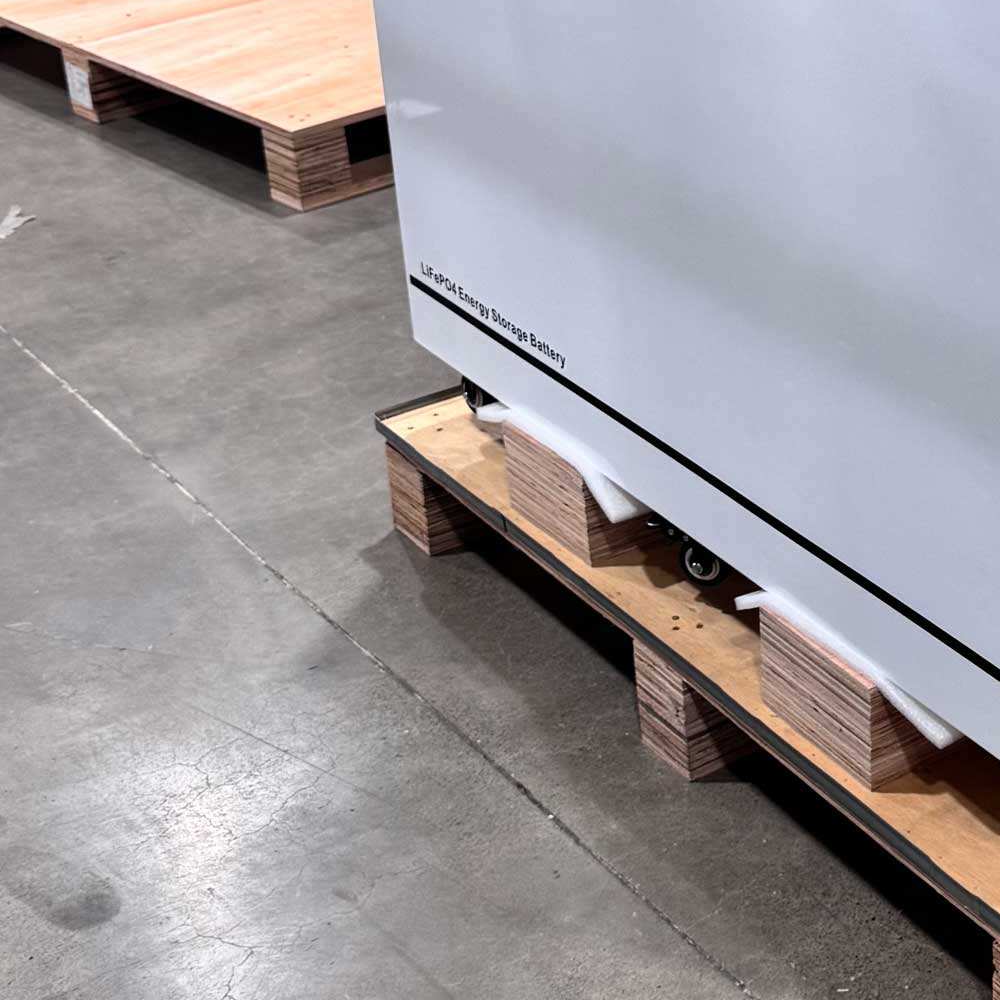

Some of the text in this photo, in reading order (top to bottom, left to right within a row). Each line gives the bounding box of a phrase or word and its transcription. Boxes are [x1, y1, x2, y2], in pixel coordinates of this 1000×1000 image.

[421, 262, 566, 368] LiFePO4 Energy Storage Battery
